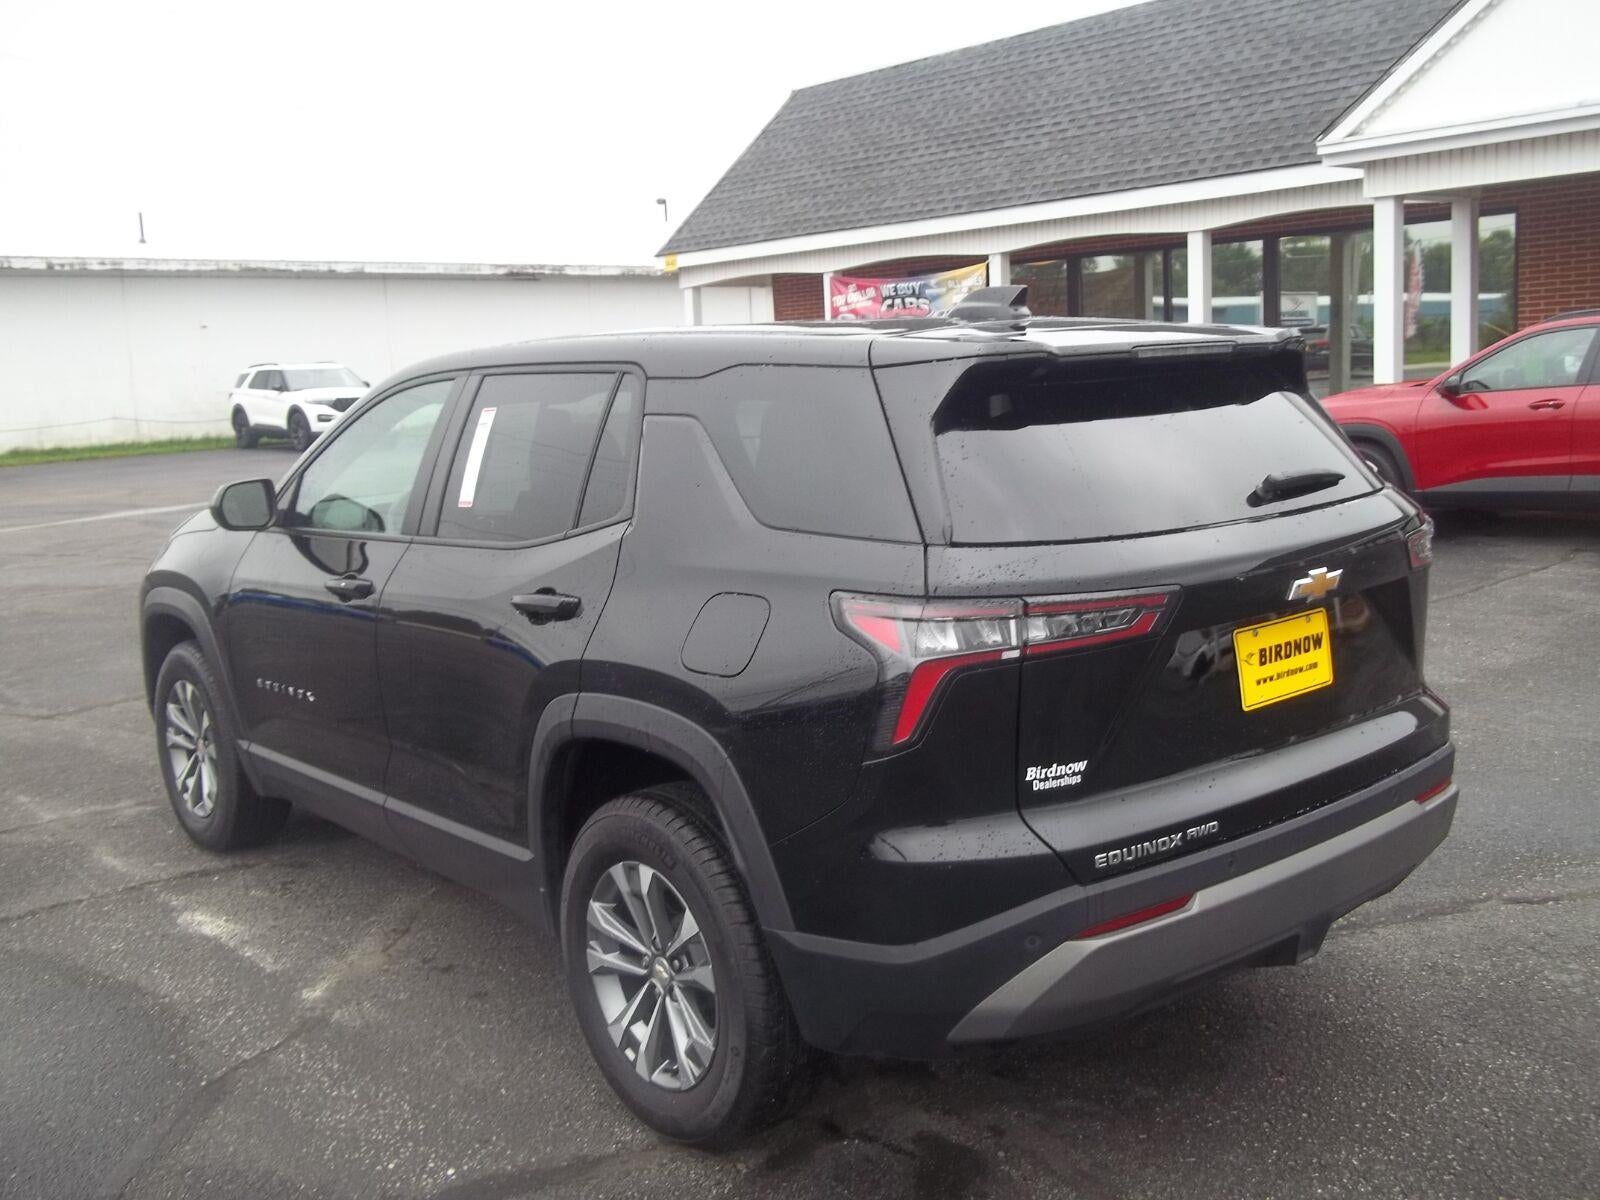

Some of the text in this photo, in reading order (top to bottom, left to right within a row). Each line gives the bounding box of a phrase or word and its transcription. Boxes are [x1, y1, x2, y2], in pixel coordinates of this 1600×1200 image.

[880, 281, 921, 298] WE BUY
[880, 297, 931, 315] CARS
[1259, 632, 1323, 667] BIRDNOW
[1256, 661, 1319, 686] www.birdnow.com
[1025, 760, 1088, 781] Birdnow
[1032, 774, 1082, 791] Dealerships
[1094, 821, 1219, 869] EQUINOX AWD
